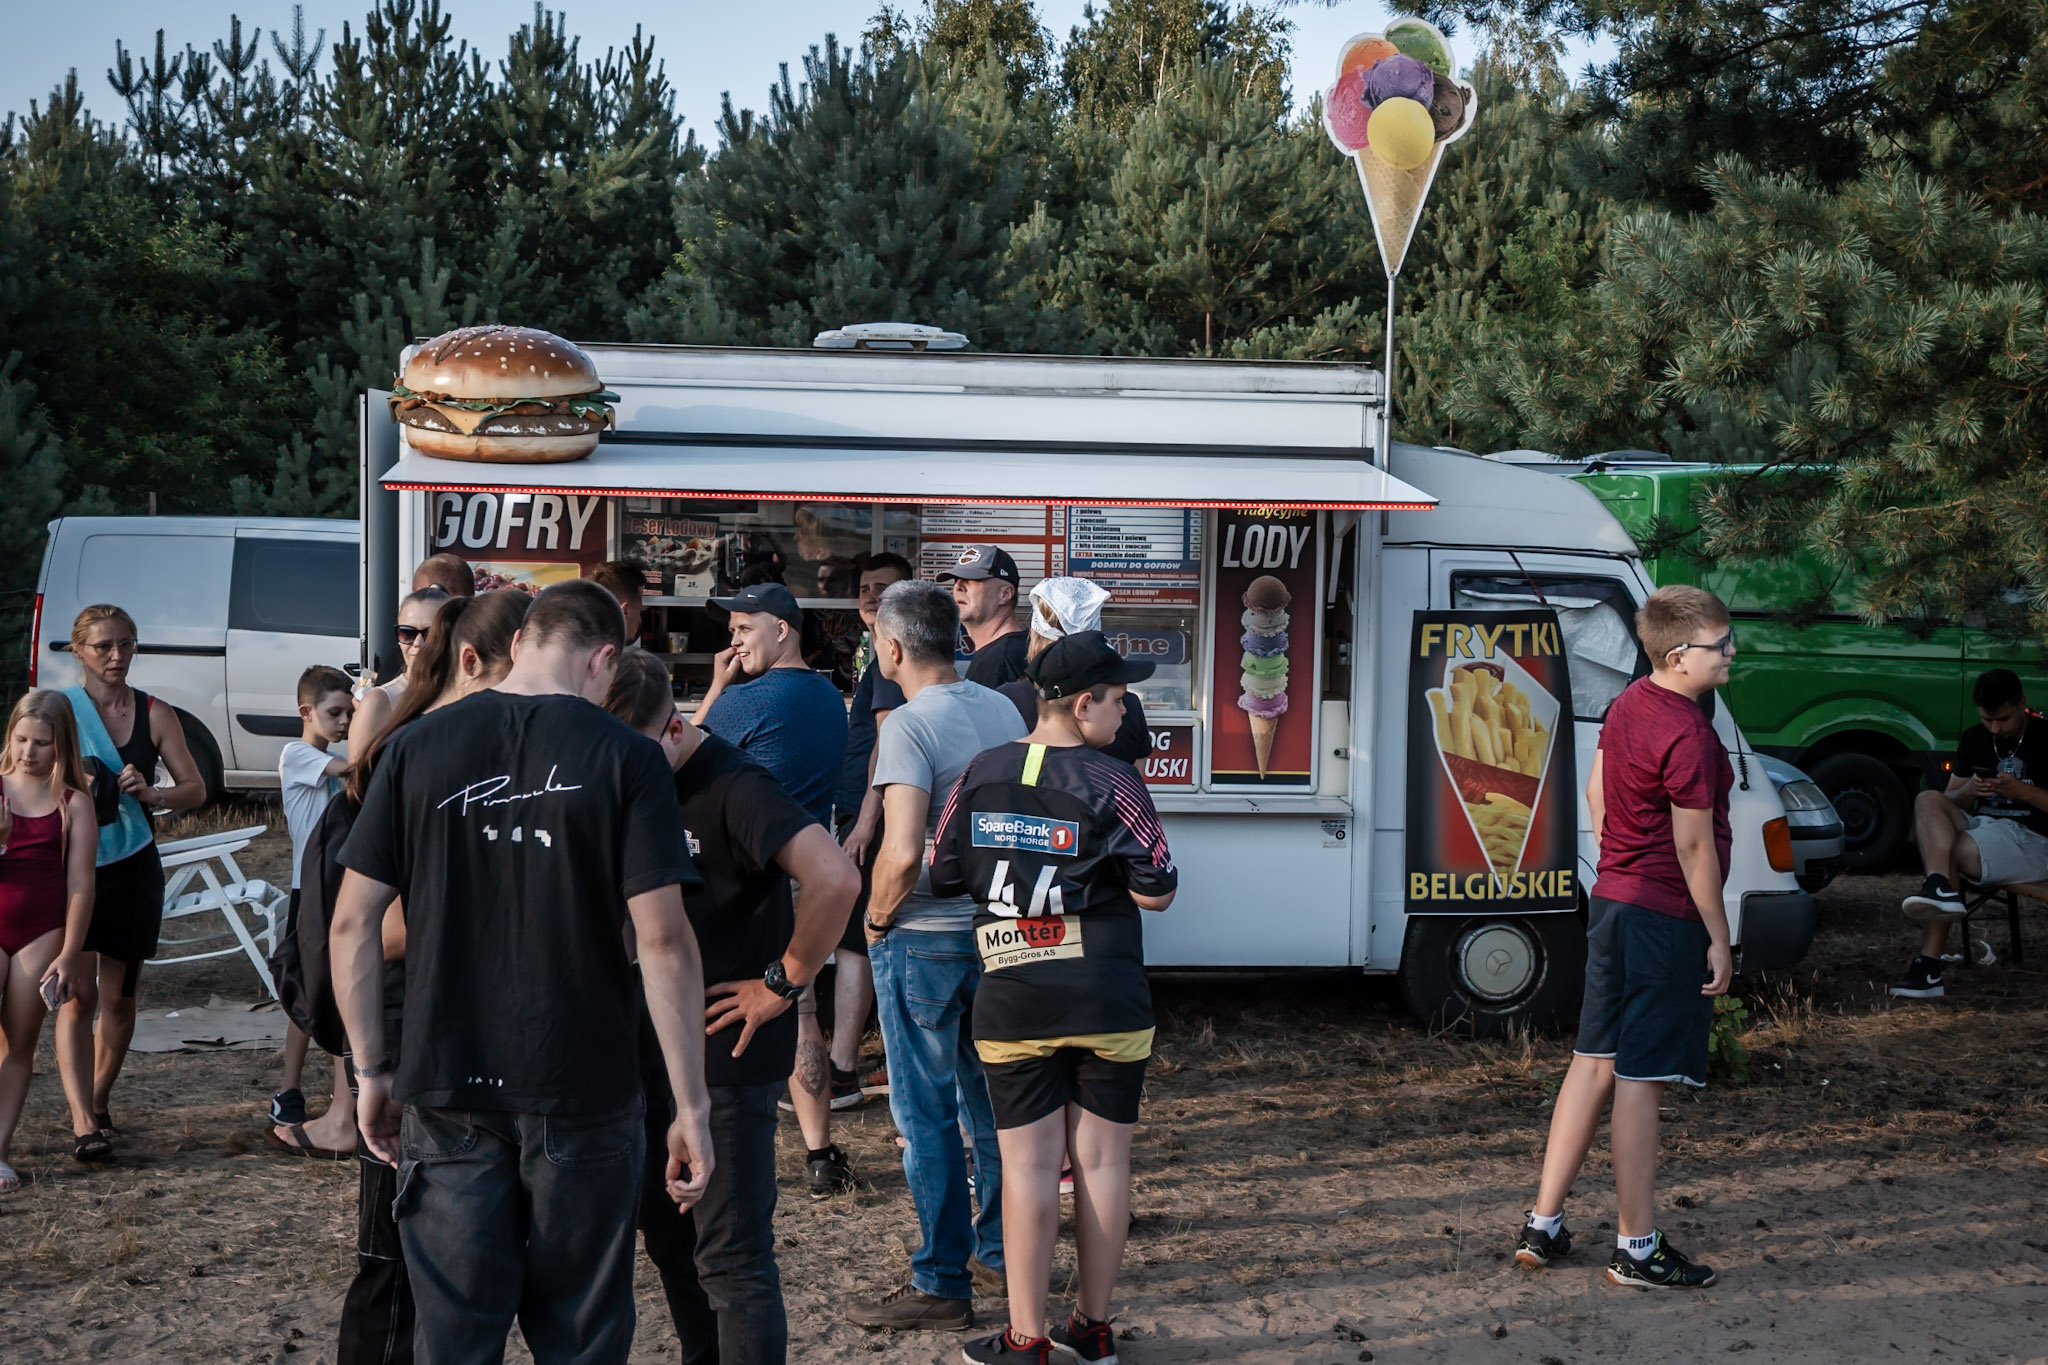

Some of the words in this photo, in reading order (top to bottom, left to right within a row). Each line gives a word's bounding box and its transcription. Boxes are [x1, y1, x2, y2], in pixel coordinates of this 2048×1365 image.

[435, 492, 600, 550] GOFRY
[623, 515, 663, 536] Deser
[664, 516, 718, 539] Lodowy
[1222, 524, 1311, 569] LODY
[1091, 561, 1127, 569] DODATKI
[1419, 623, 1560, 658] FRYTKI
[978, 818, 1050, 838] SpareBank
[1410, 869, 1574, 900] BELGIJSKIE
[985, 921, 1062, 949] Montér
[998, 951, 1041, 965] Bygg-Gros
[1043, 949, 1056, 957] AS
[1629, 1236, 1654, 1249] RUN
